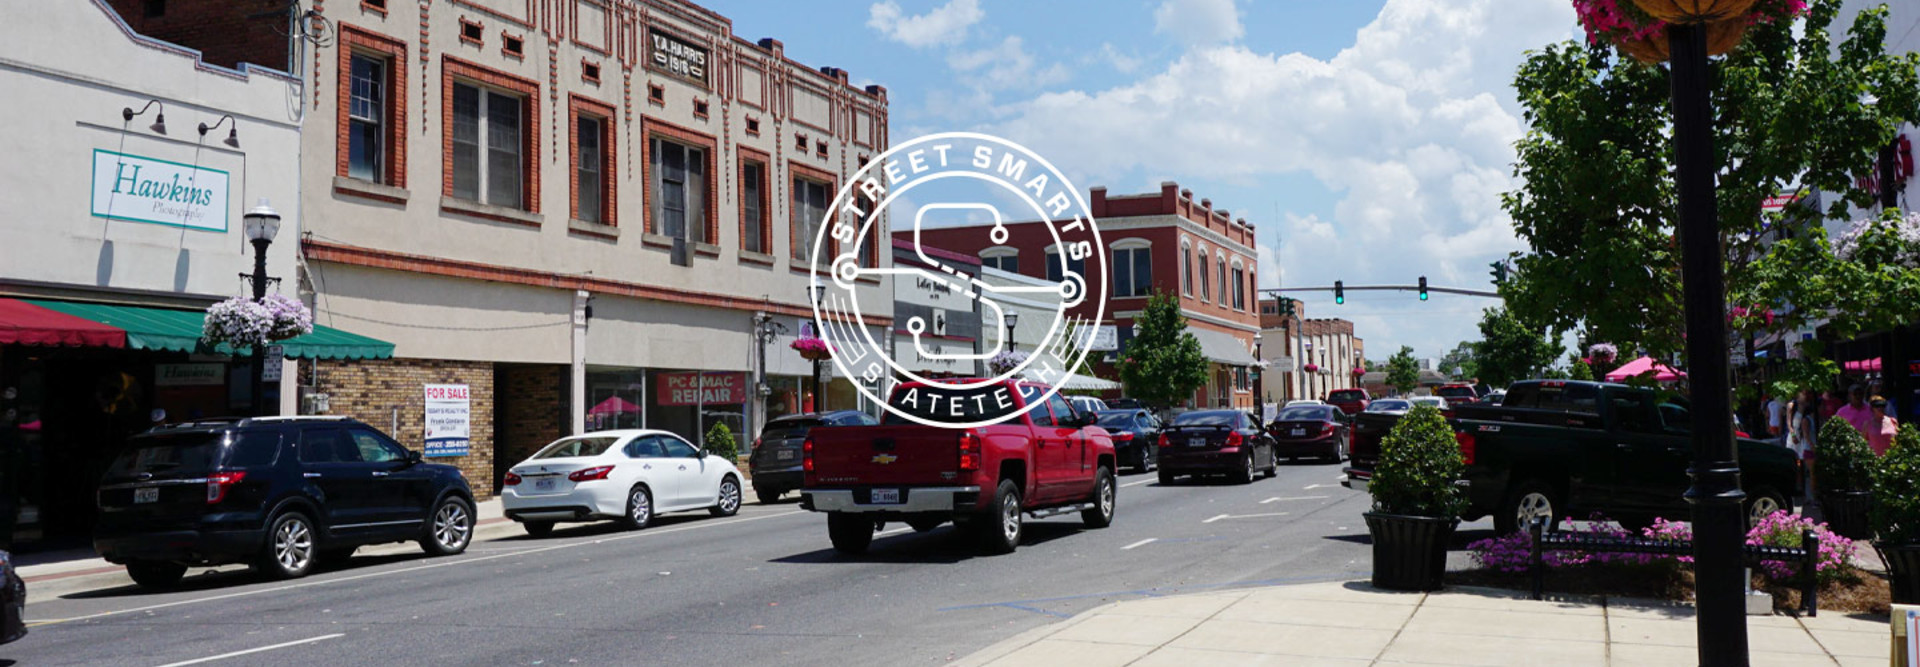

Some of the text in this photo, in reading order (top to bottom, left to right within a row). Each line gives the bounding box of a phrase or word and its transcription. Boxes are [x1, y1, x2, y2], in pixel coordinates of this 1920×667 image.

[111, 162, 213, 206] Hawkins
[152, 200, 206, 221] Photography
[668, 375, 734, 387] PC & MAC
[427, 388, 468, 399] FOR SALE
[672, 388, 731, 403] REPAIR
